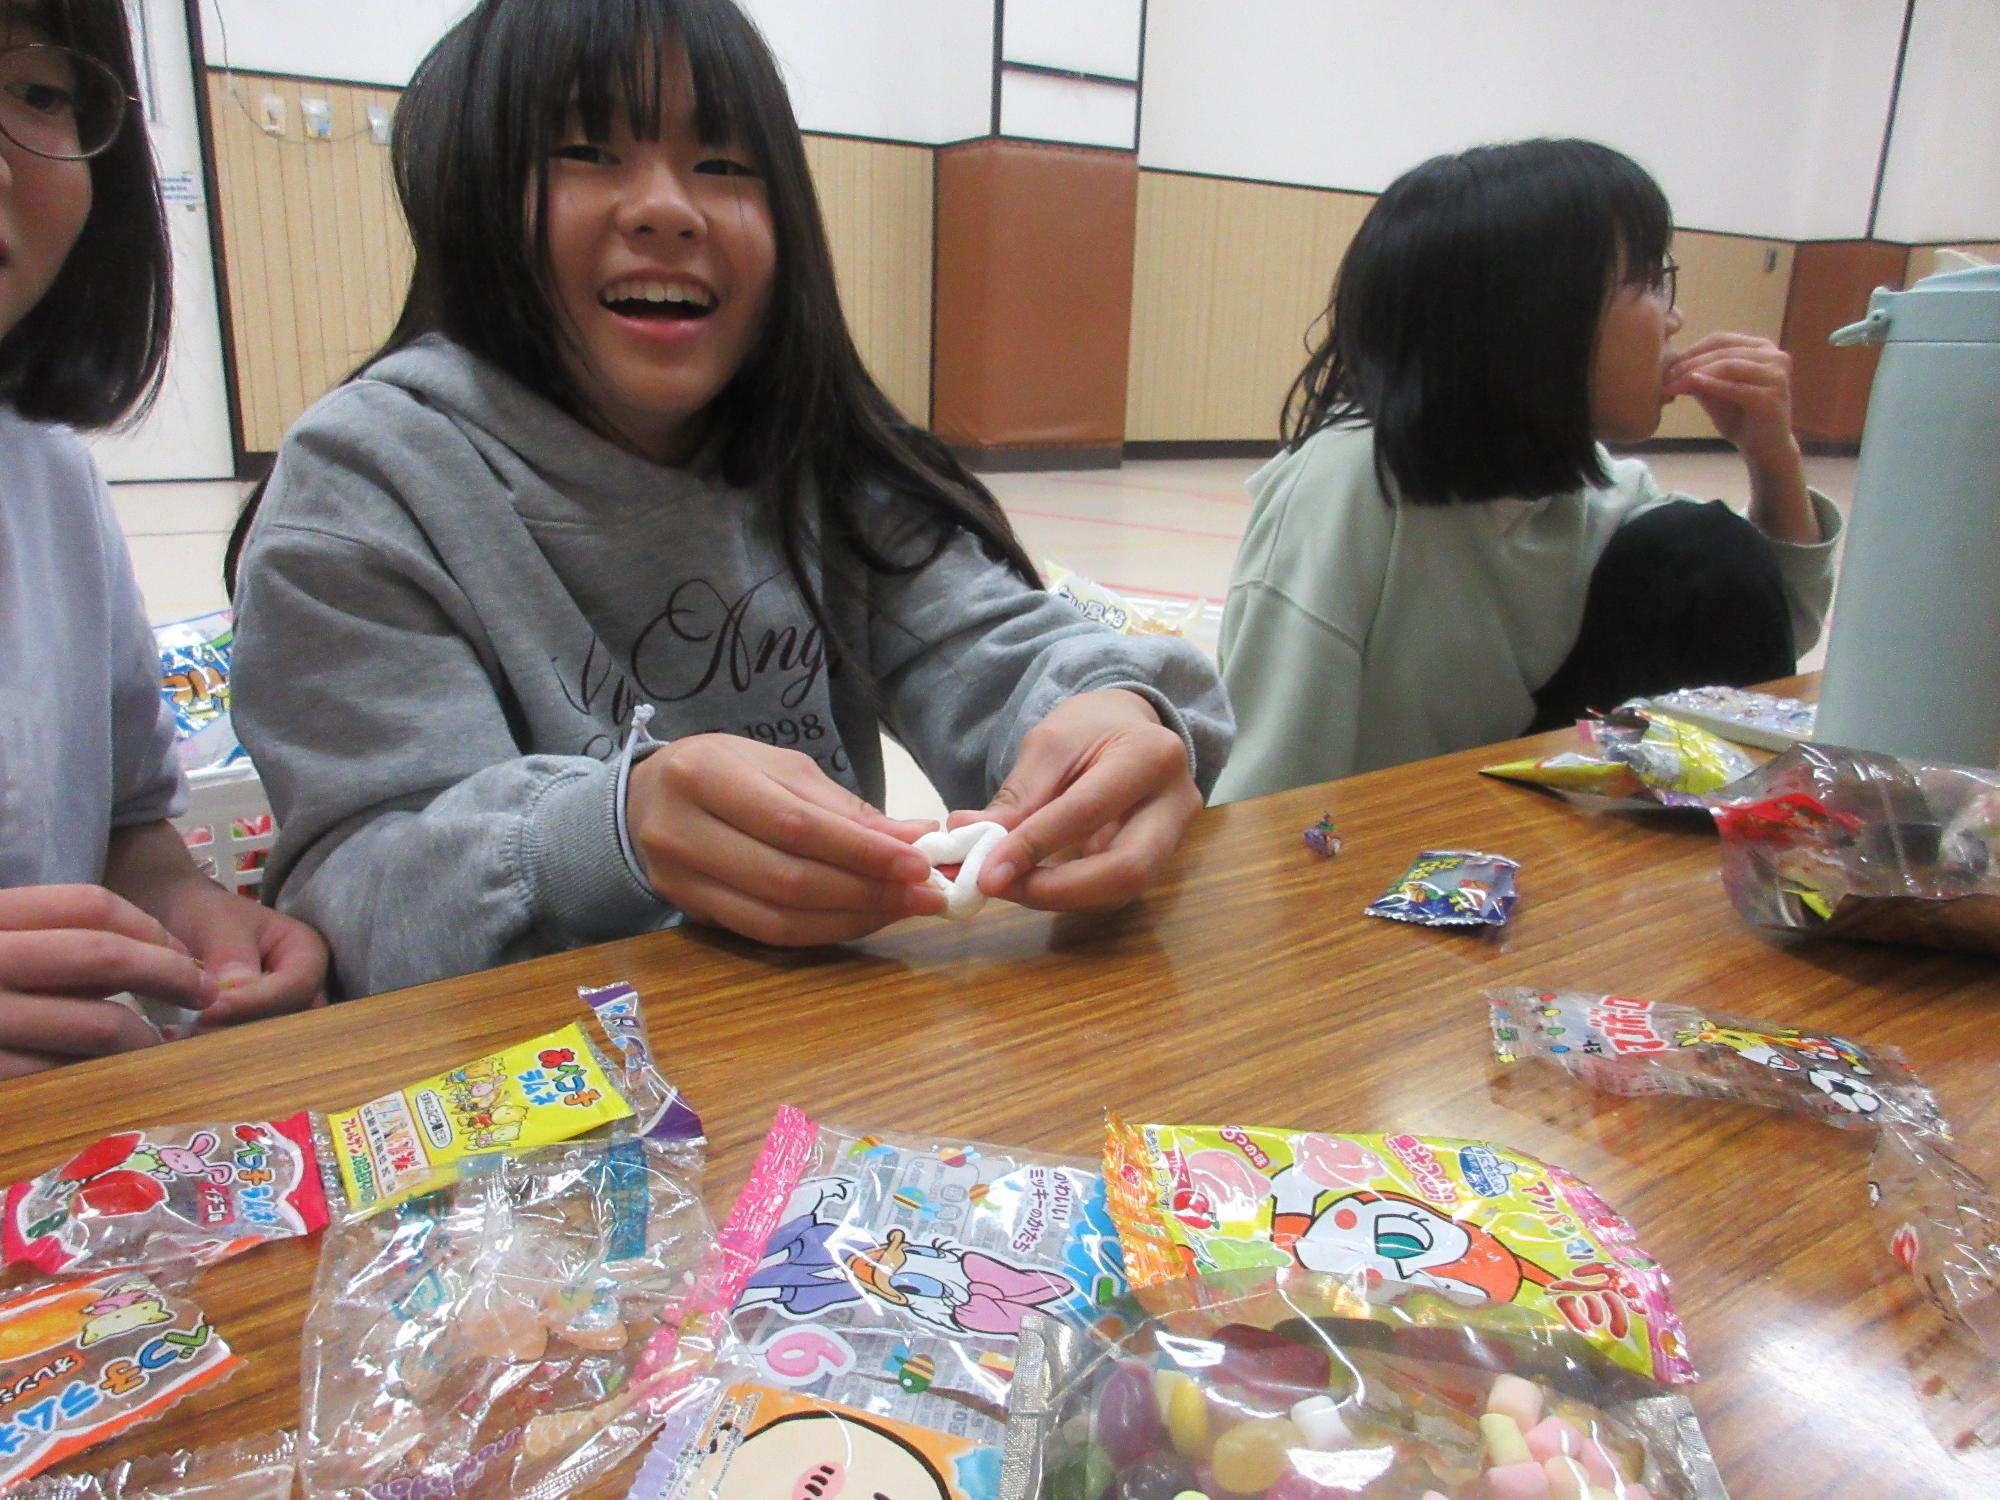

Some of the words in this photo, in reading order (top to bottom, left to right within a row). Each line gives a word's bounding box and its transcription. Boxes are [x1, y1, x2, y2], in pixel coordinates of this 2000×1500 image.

[632, 571, 827, 708] Ang
[517, 1068, 560, 1106] ラムネ
[1012, 1169, 1049, 1253] ミッキーのかたち
[1051, 1171, 1071, 1221] かわいい
[0, 1324, 210, 1455] べっ子ラムネ
